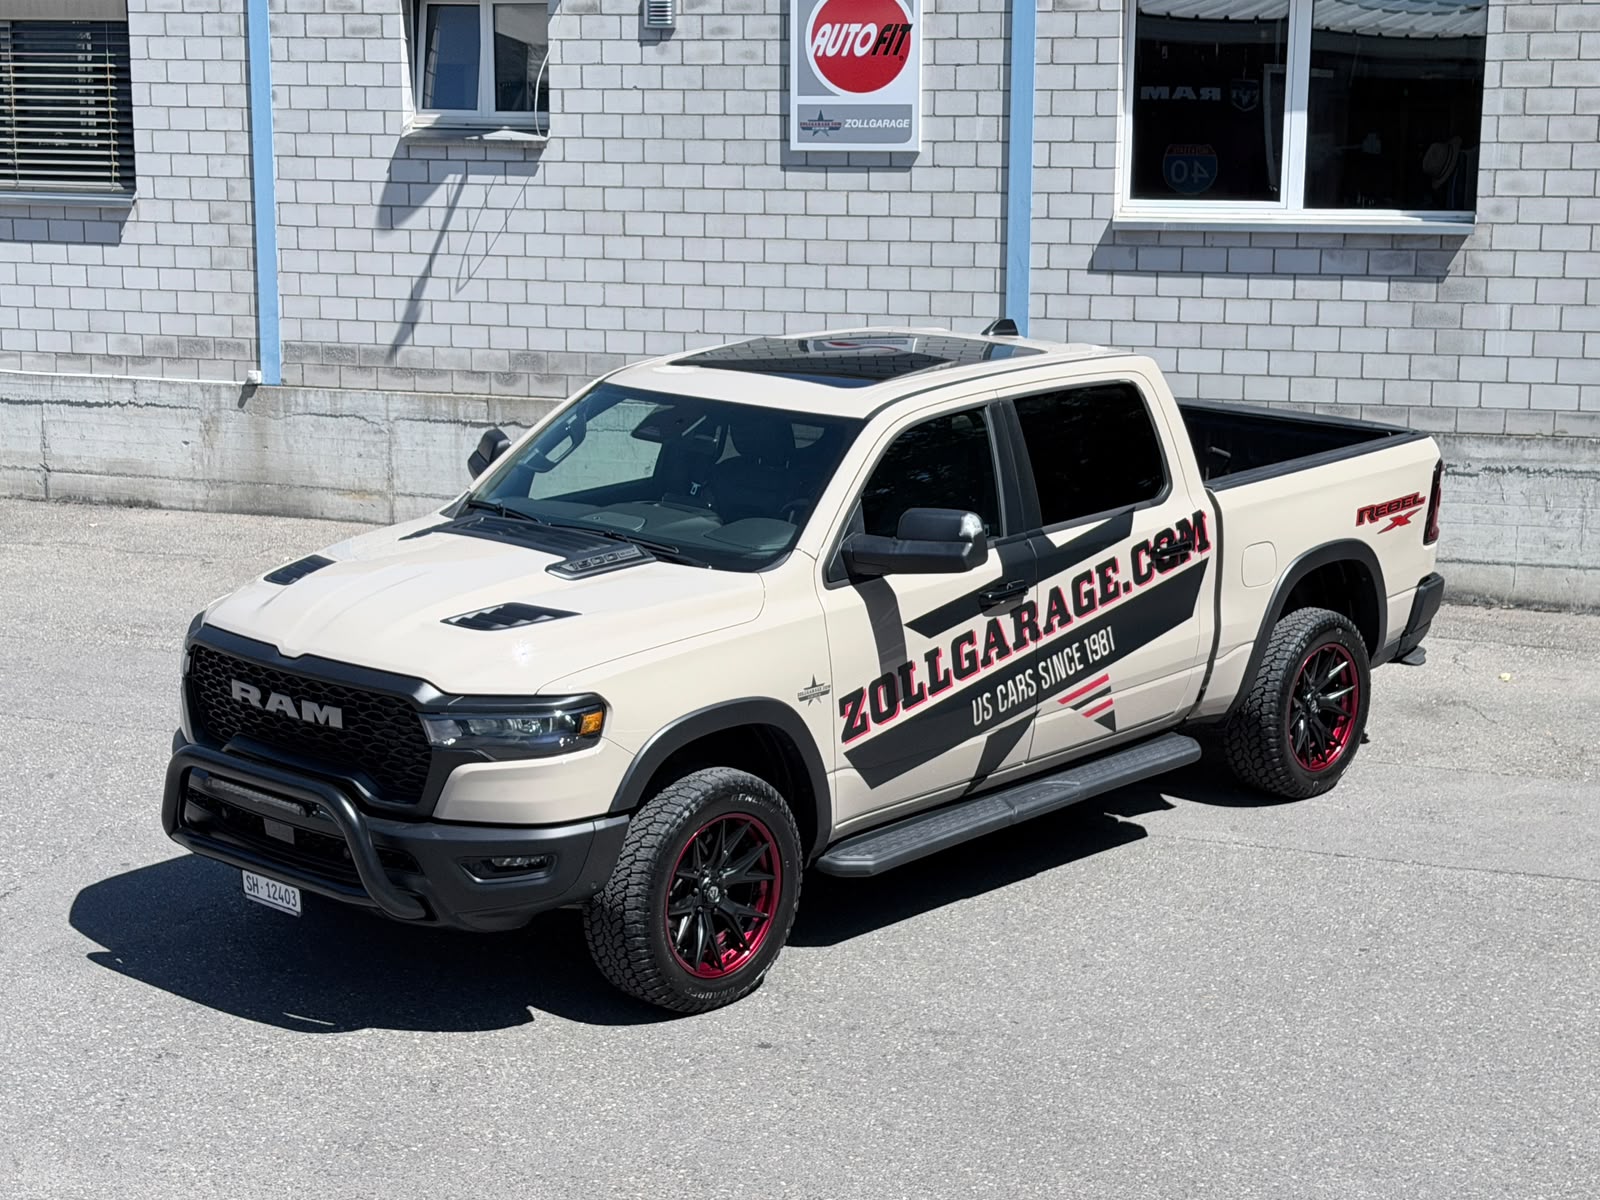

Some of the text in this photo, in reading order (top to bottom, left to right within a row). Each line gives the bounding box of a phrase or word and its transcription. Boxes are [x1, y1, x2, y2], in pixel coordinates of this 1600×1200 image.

[811, 22, 913, 57] AUTOFIT
[844, 119, 910, 128] ZOLLGARAGE
[1355, 491, 1427, 527] REBEL
[568, 551, 619, 571] 1500
[838, 509, 1211, 745] ZOLLGARAGE.COM
[971, 625, 1115, 726] US CARS SINCE 1981
[231, 678, 343, 729] RAM
